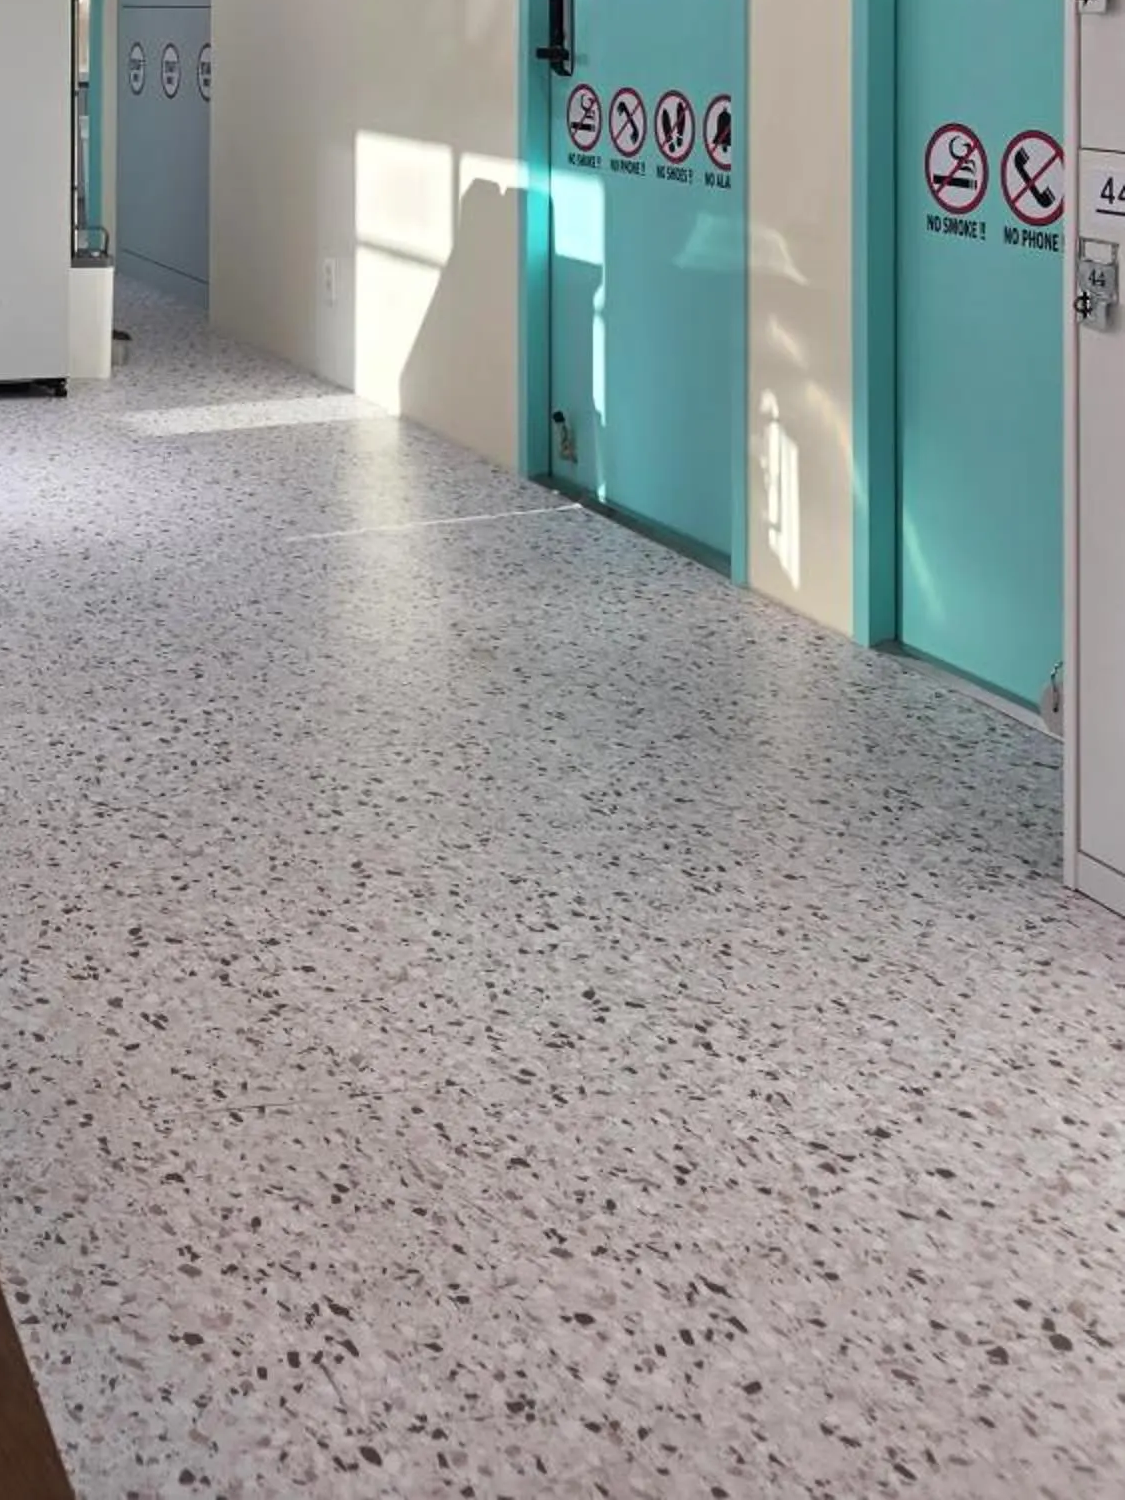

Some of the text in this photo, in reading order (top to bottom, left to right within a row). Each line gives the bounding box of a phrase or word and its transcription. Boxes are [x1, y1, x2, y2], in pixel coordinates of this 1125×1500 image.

[705, 171, 715, 188] NO
[926, 214, 942, 233] NO
[943, 217, 977, 238] SMOKE
[1004, 226, 1059, 252] NO PHONE
